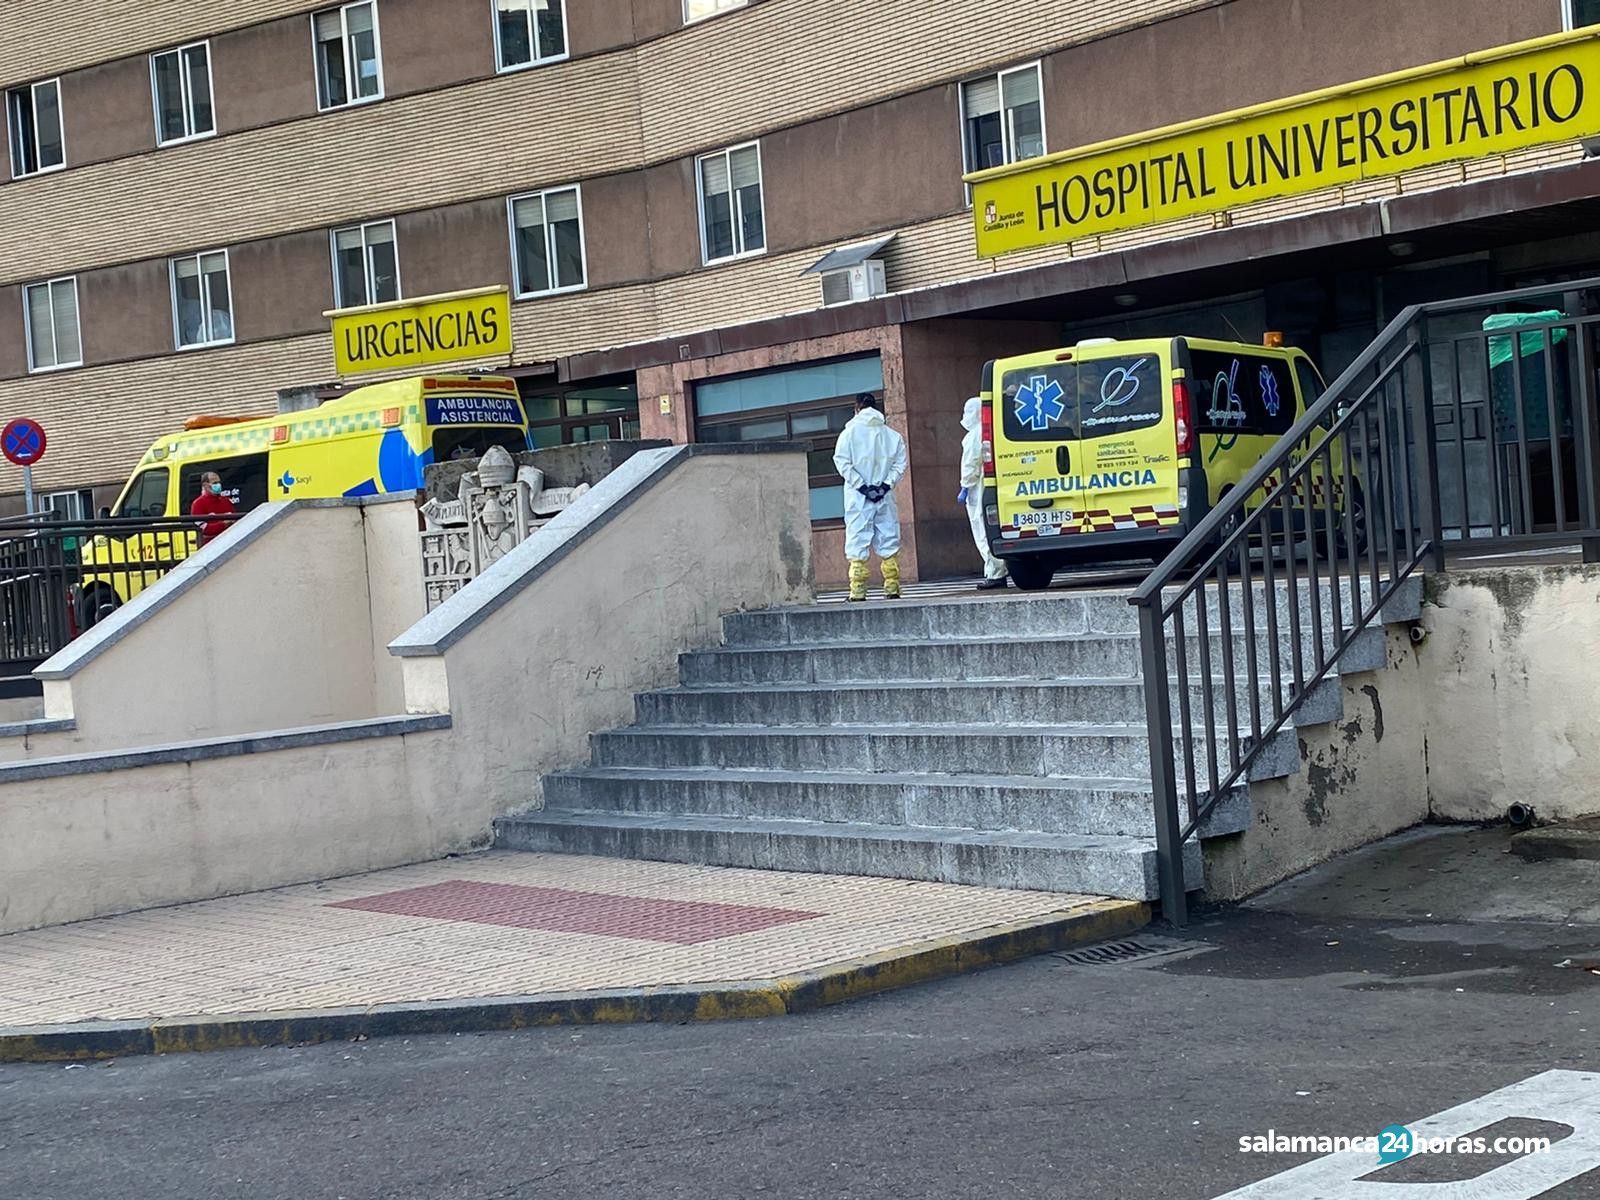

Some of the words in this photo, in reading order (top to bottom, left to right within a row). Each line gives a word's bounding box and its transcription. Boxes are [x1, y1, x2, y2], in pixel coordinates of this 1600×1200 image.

[1035, 146, 1217, 231] HOSPITAL
[1228, 63, 1584, 190] UNIVERSITARIO
[999, 213, 1015, 222] Junta
[345, 306, 498, 362] URGENCIAS
[437, 398, 513, 410] AMBULANCIA
[441, 411, 516, 423] ASISTENCIAL
[296, 475, 312, 485] Sacyl
[1015, 468, 1157, 497] AMBULANCIA
[1020, 512, 1047, 525] 3803
[1051, 510, 1072, 522] HTS
